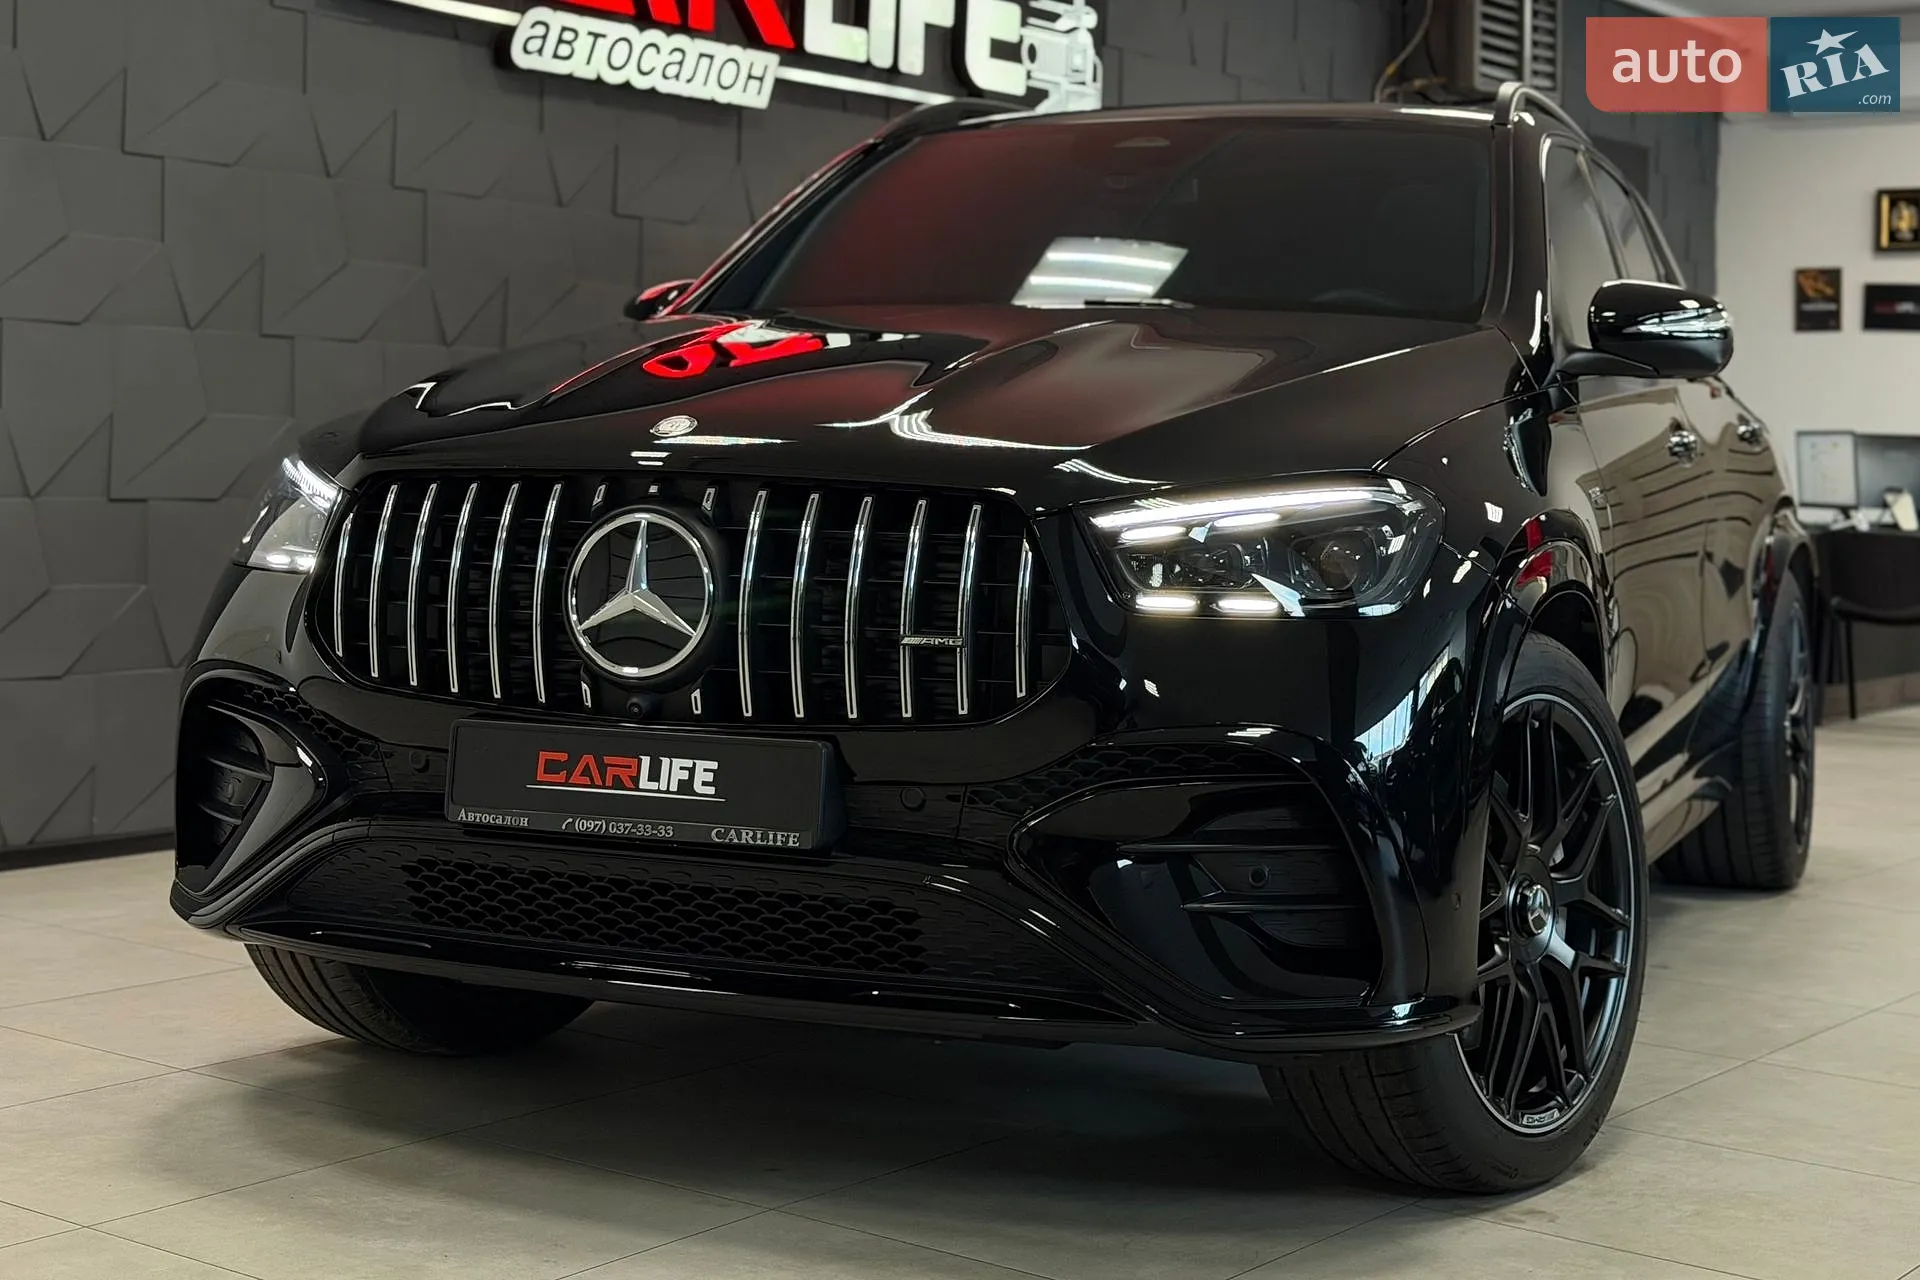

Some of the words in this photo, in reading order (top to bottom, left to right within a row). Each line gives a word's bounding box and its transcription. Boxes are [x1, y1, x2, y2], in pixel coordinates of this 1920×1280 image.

[522, 20, 770, 96] автосалон
[536, 751, 719, 794] CARLIFE
[457, 808, 529, 827] Автосалон
[574, 817, 607, 834] (097)
[608, 821, 675, 838] 037-33-33
[711, 828, 800, 847] CARLIFE
